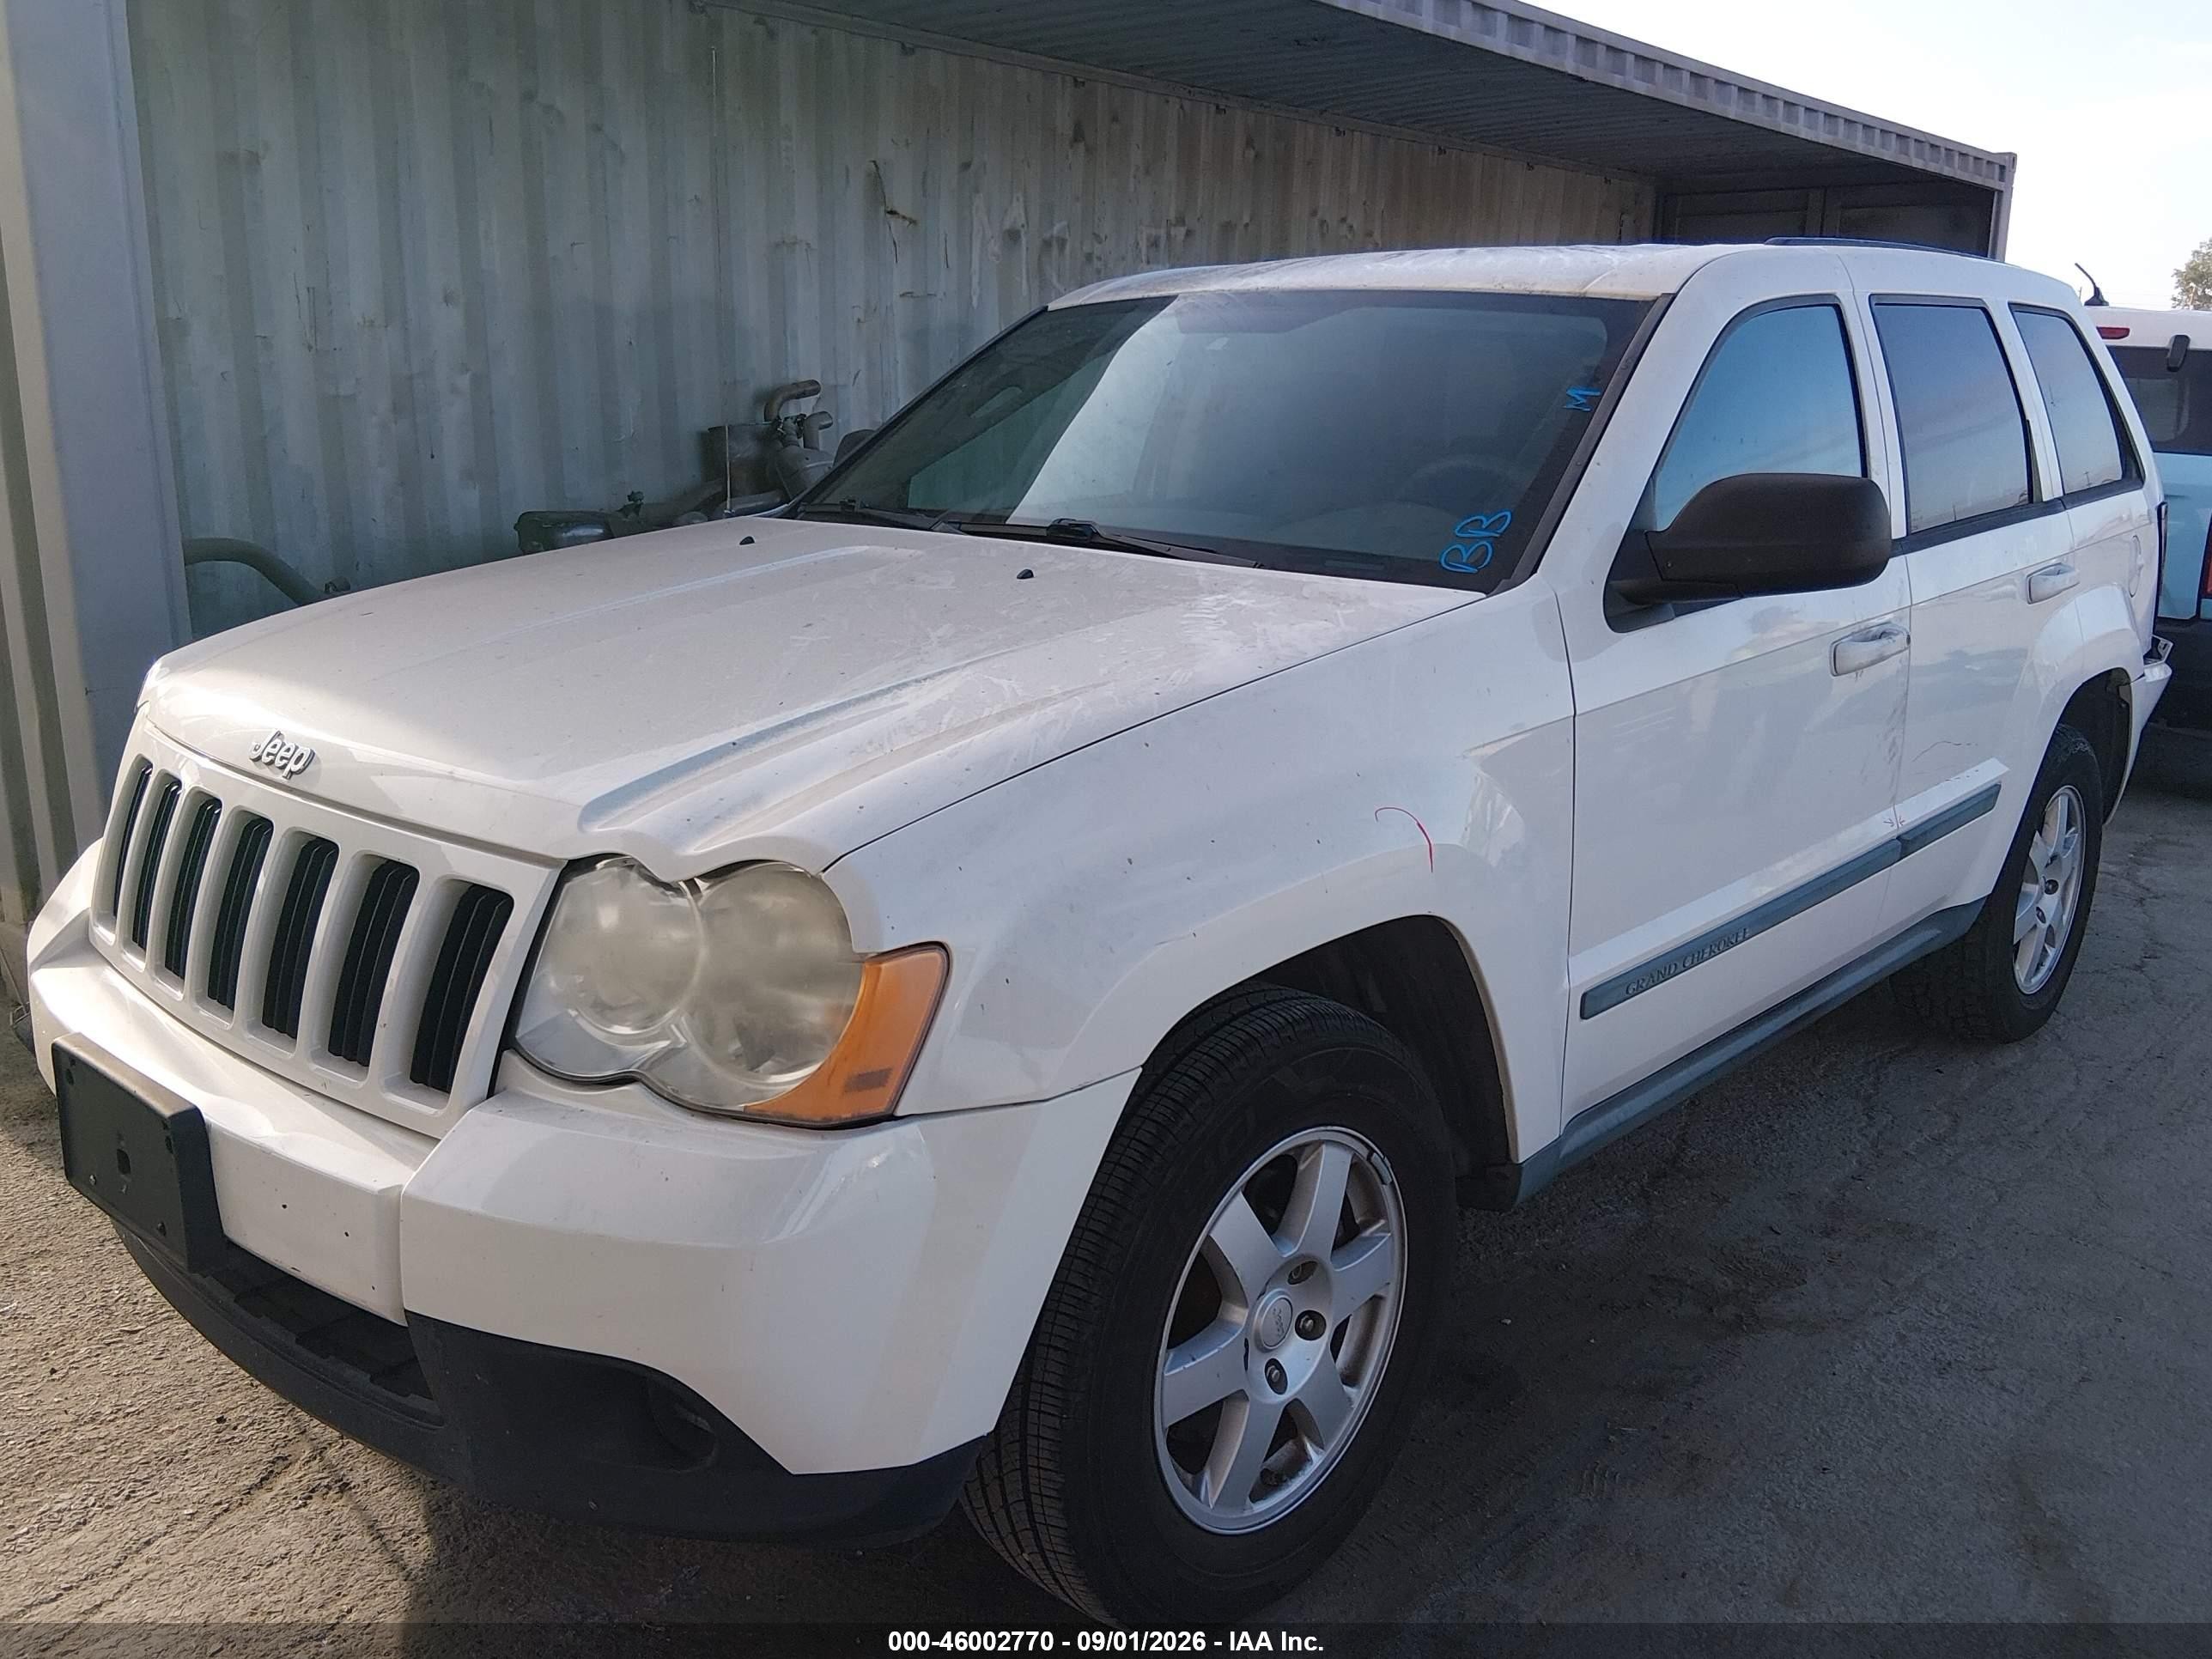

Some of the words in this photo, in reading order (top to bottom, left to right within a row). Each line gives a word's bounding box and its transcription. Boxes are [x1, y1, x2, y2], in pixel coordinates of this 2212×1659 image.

[248, 729, 316, 780] Jeep
[1625, 962, 1678, 996] GRAND
[1681, 927, 1750, 969] CHEROKEE
